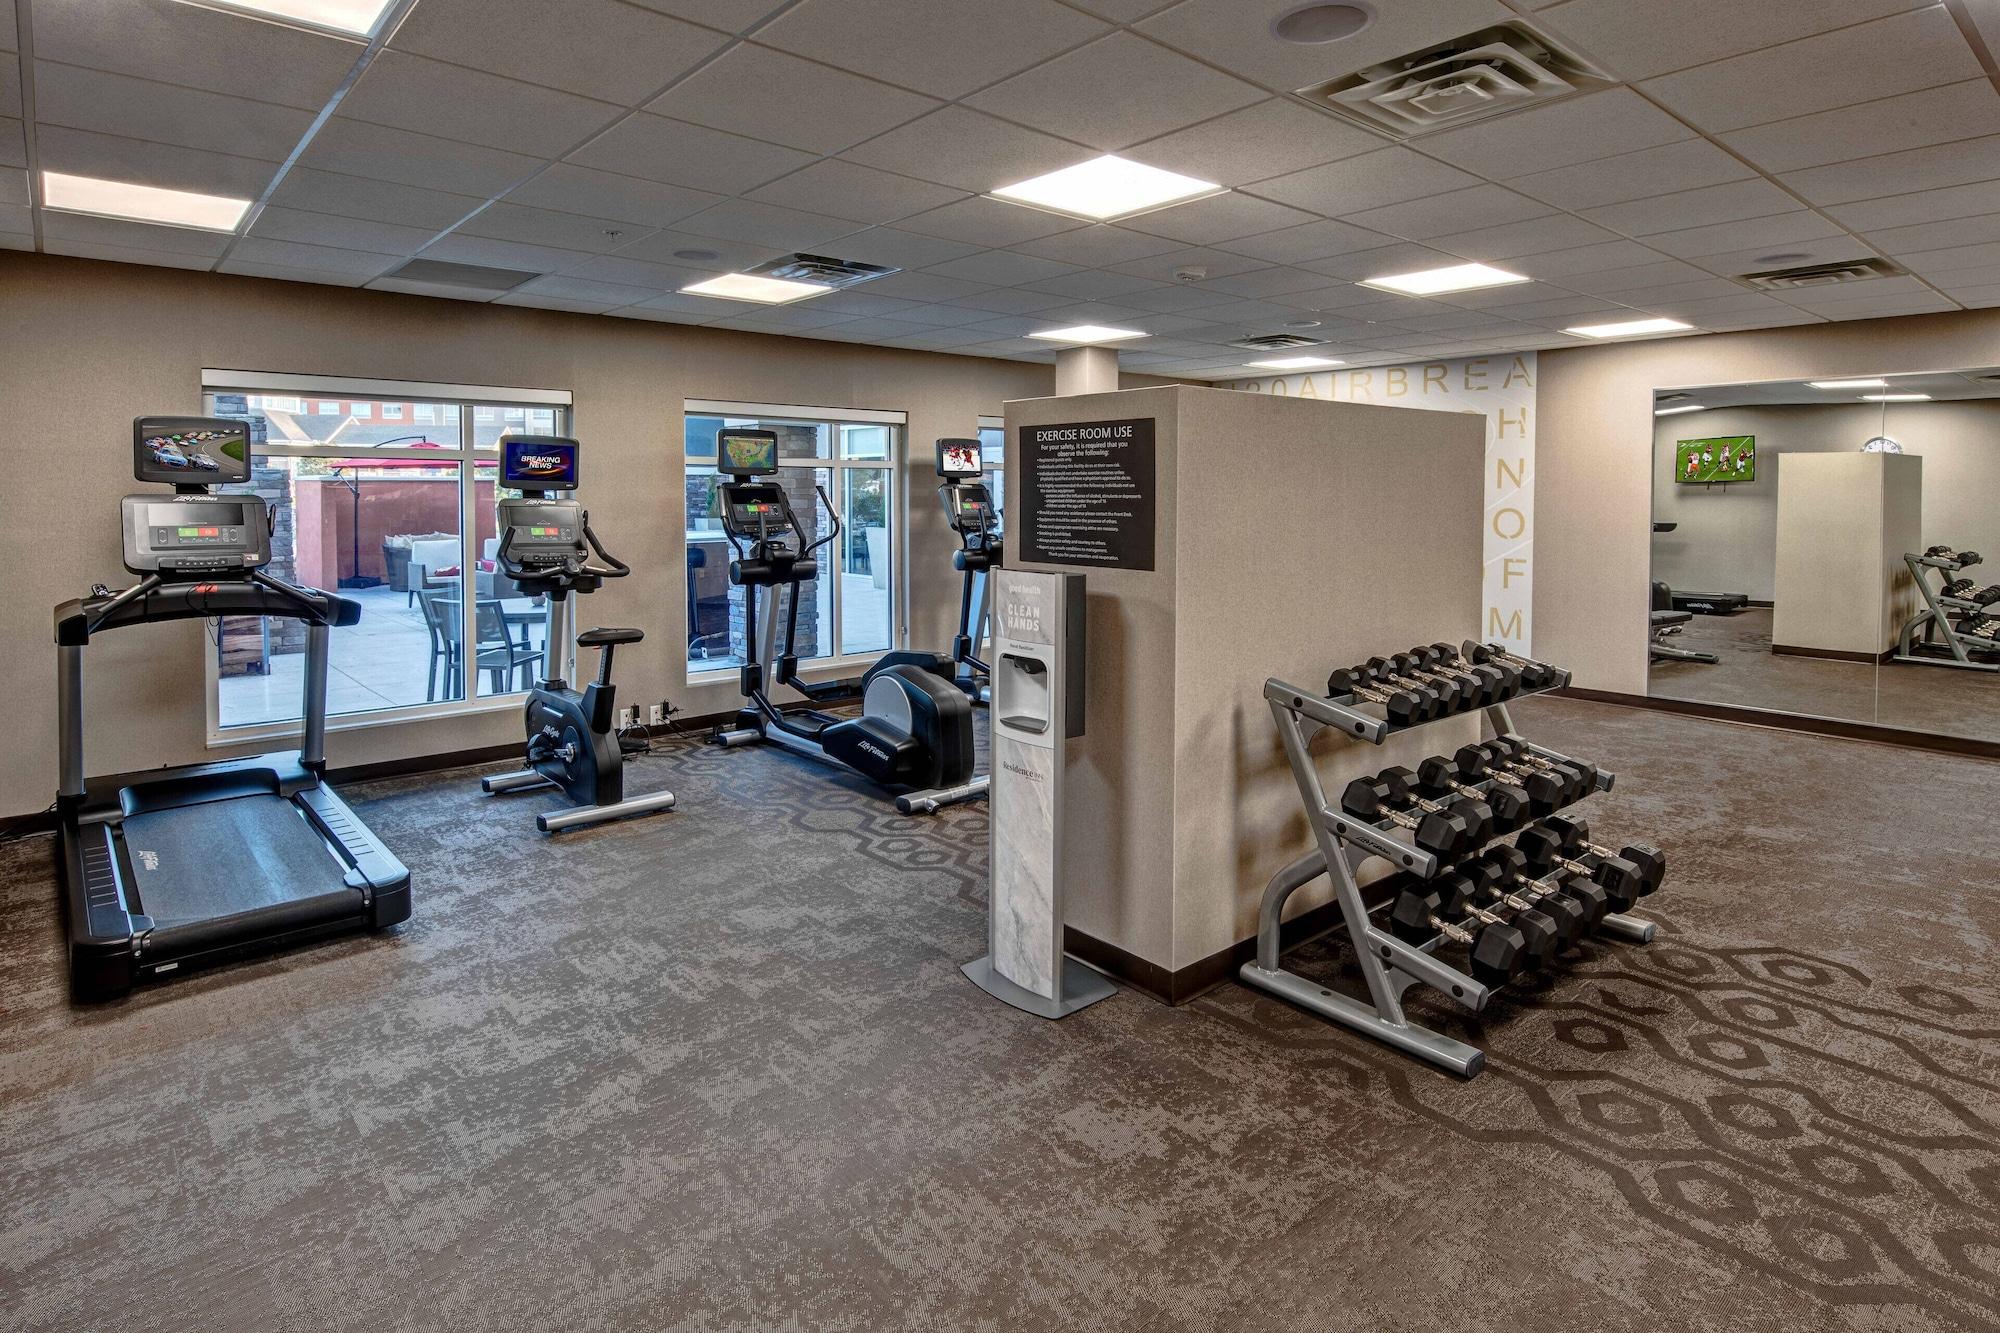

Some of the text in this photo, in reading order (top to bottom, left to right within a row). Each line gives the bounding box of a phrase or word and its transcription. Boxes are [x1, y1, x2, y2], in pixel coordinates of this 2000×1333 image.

[1036, 426, 1132, 442] EXERCISE ROOM USE
[1085, 441, 1106, 450] required
[1117, 441, 1128, 449] you
[1008, 604, 1040, 618] CLEAN
[1007, 616, 1040, 631] HANDS
